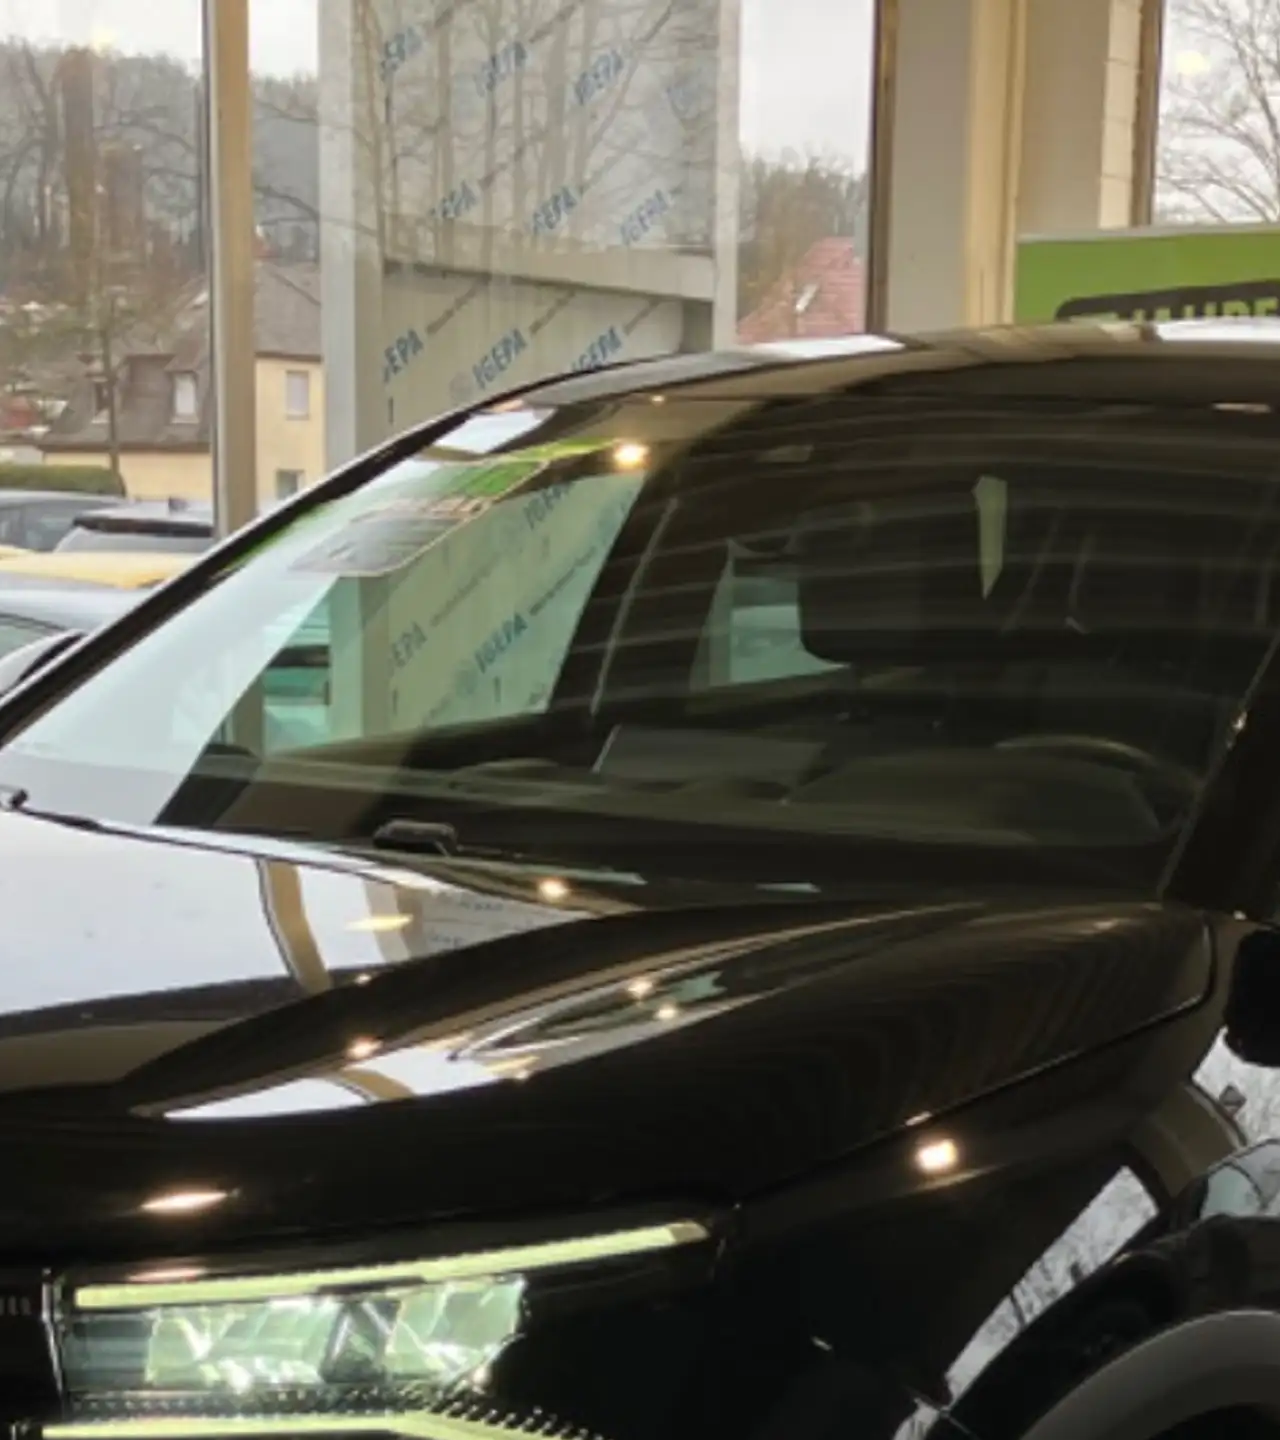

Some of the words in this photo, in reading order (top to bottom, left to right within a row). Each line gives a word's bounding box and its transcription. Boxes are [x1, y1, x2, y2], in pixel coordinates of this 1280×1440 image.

[472, 327, 528, 389] IGEPA
[390, 622, 428, 668] EPA
[474, 612, 529, 675] IGEPA
